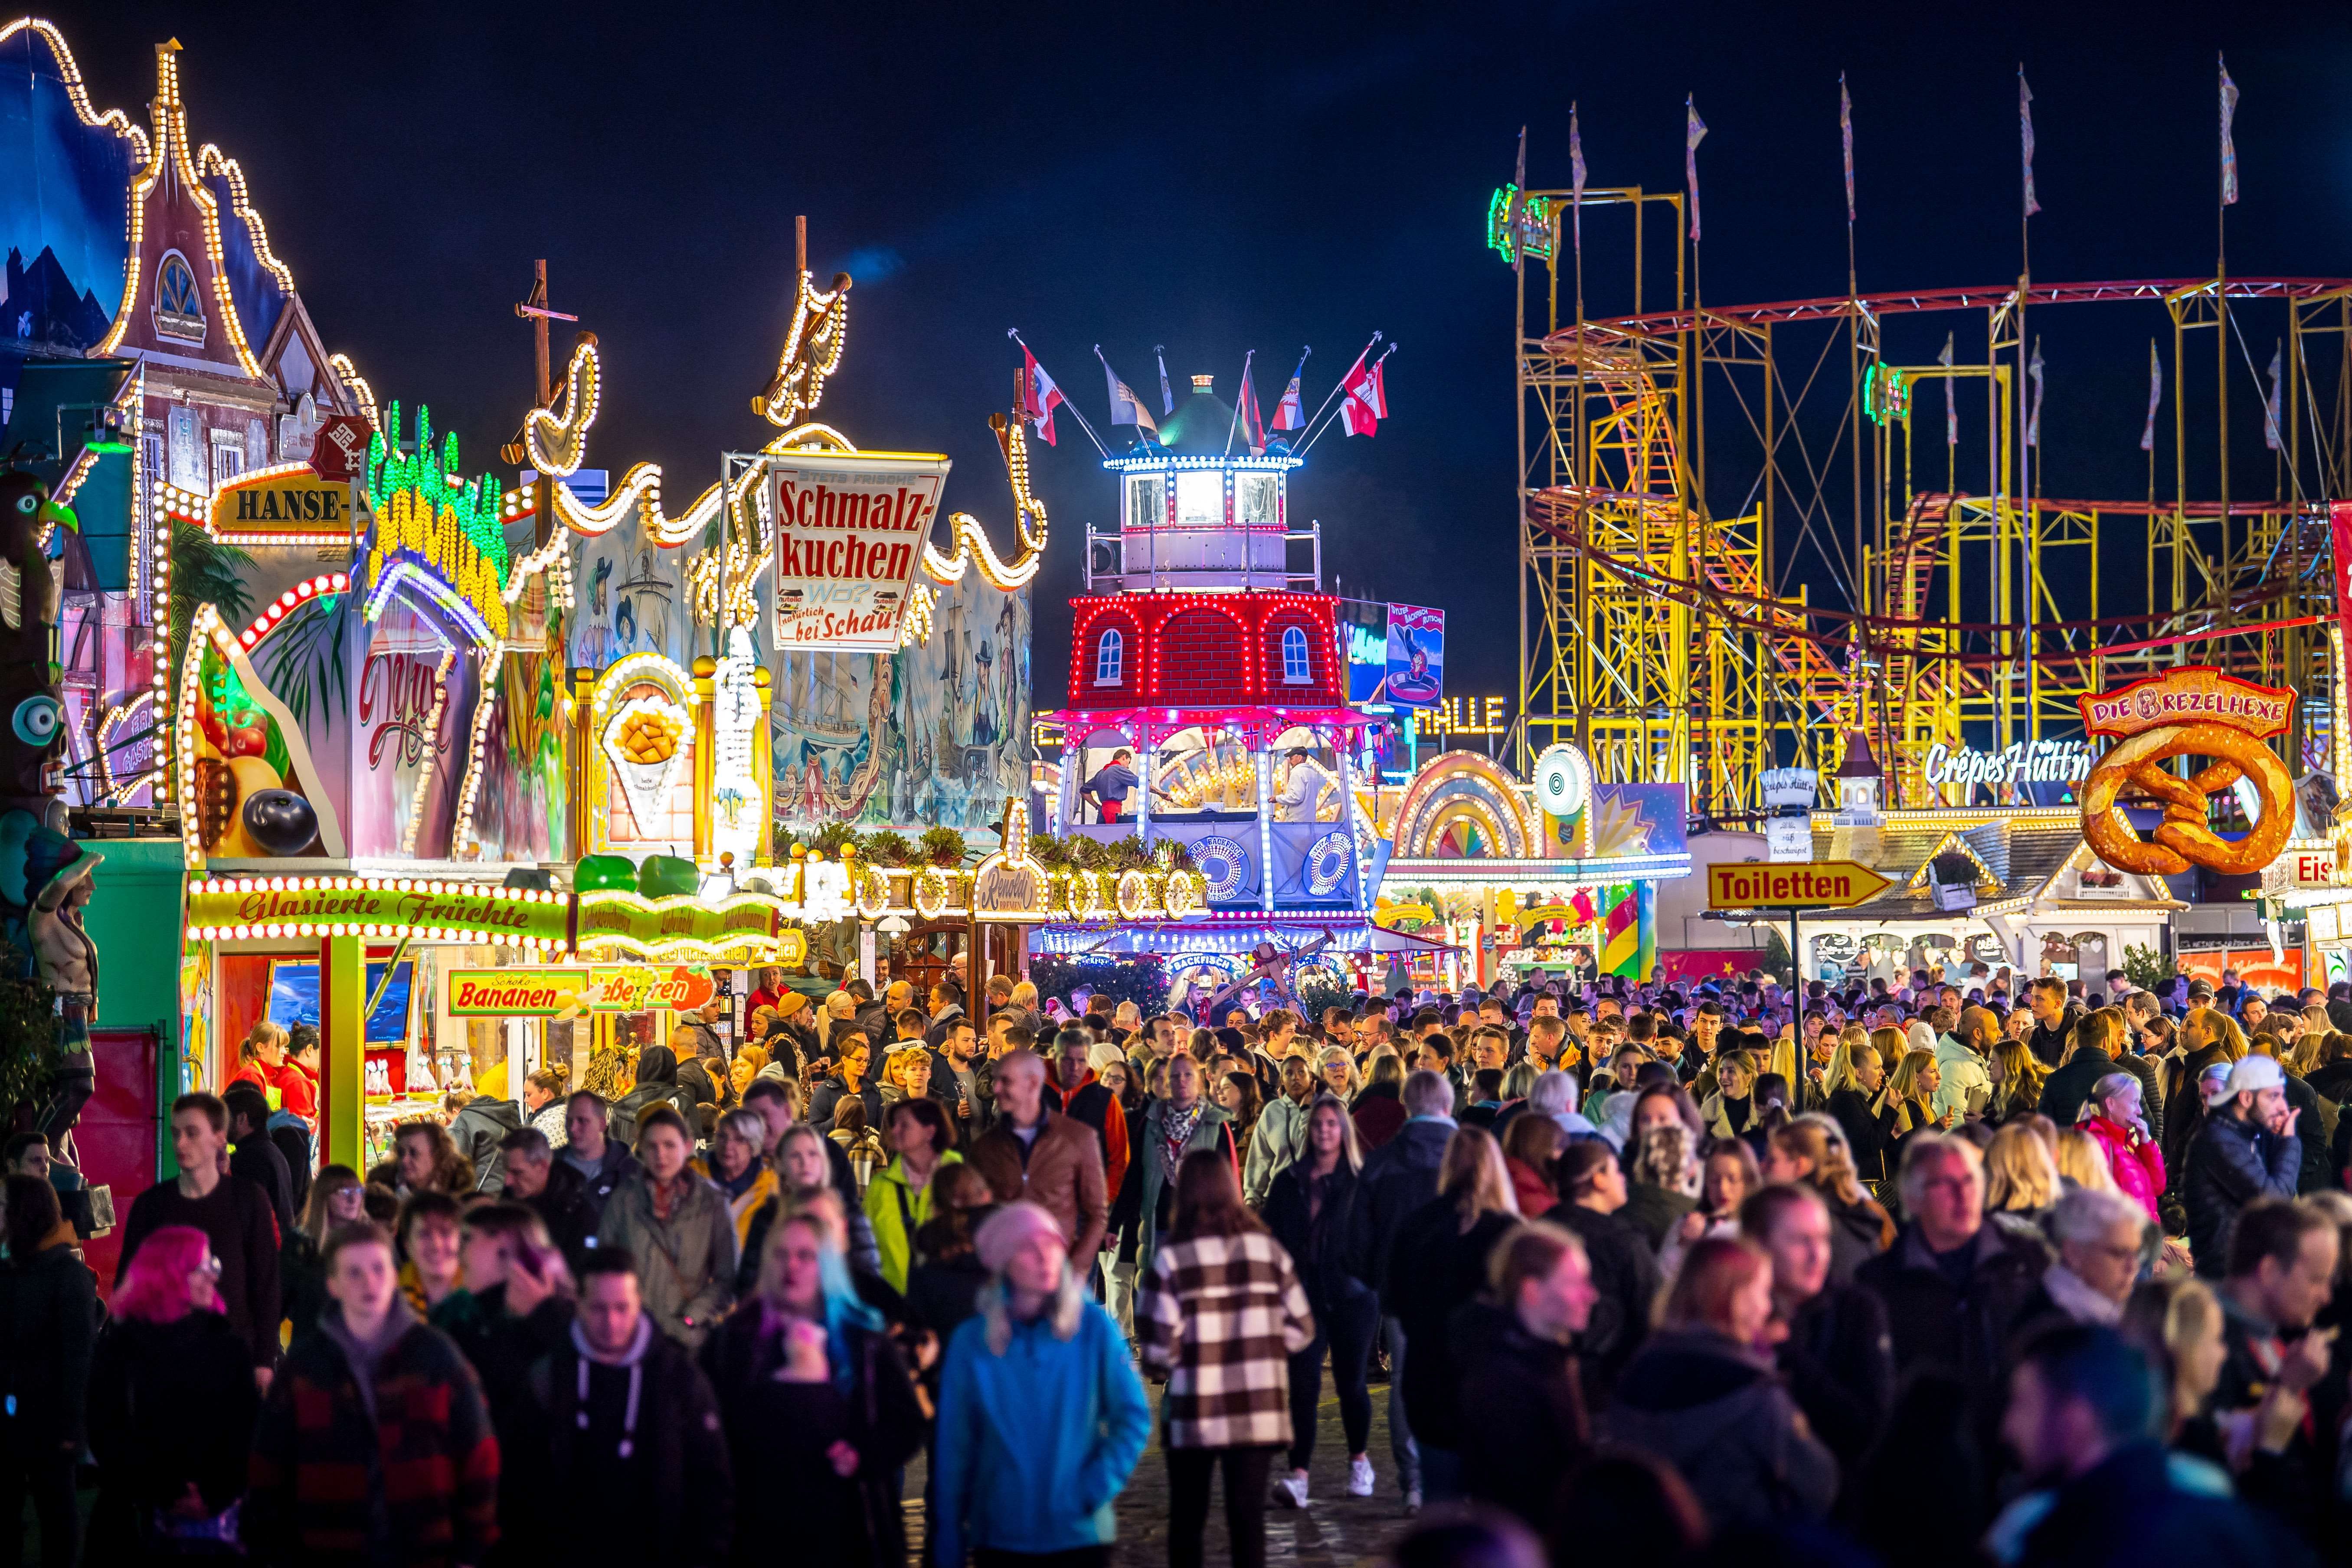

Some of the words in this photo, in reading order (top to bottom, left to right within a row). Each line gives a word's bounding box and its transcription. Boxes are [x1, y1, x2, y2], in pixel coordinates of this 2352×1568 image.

[799, 470, 847, 483] STETS
[853, 474, 916, 485] FRISCHE
[779, 480, 934, 531] Schmalz-
[781, 532, 912, 580] kuchen
[808, 583, 871, 603] Wo?
[1391, 604, 1409, 615] SYLTER
[795, 619, 819, 642] bei
[822, 599, 905, 638] Schau!
[1423, 615, 1442, 625] RUTSCHE
[2092, 697, 2131, 722] DIE
[2136, 687, 2286, 721] BREZELHEXE
[1207, 838, 1243, 857] BACKFISCH
[2299, 856, 2333, 881] Eis
[1208, 890, 1235, 900] UTSCHE
[1717, 871, 1850, 900] Toiletten
[236, 892, 382, 925] Glasierte
[397, 894, 529, 929] Früchte
[1000, 901, 1022, 910] BREMEN
[1173, 955, 1230, 971] BACKFISCH
[492, 974, 537, 986] Schoko-
[457, 982, 557, 1008] Bananen
